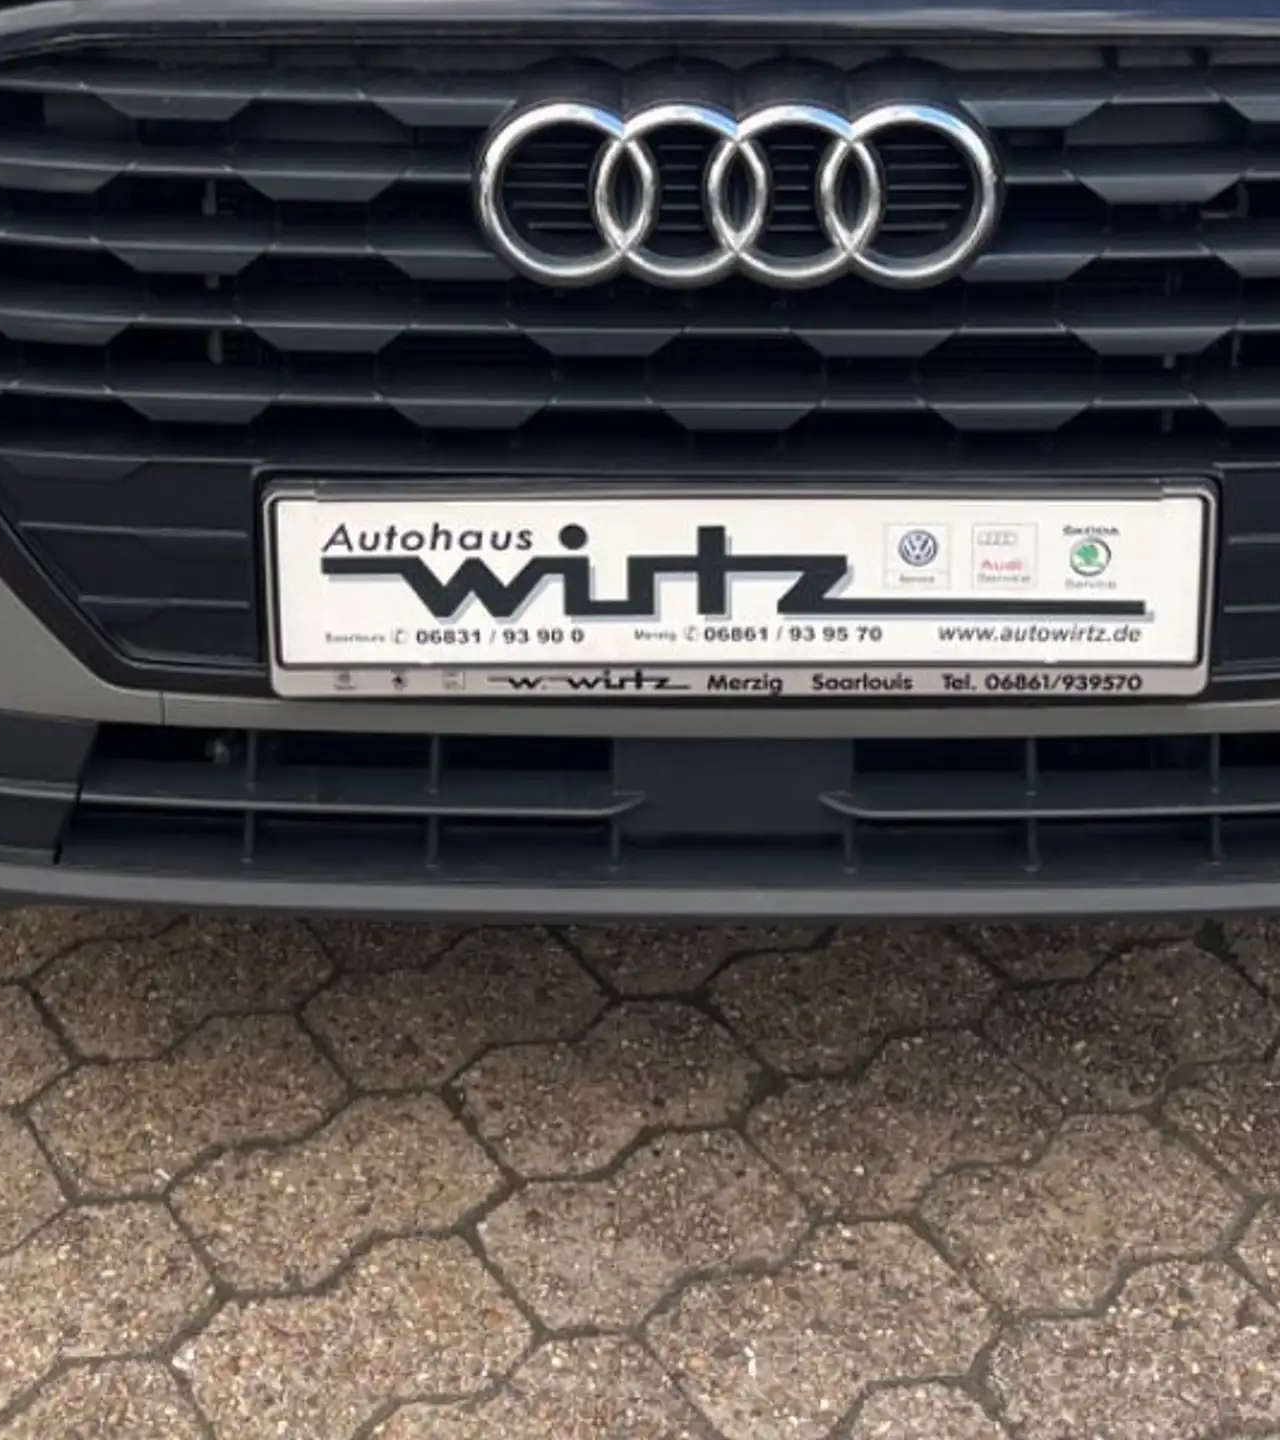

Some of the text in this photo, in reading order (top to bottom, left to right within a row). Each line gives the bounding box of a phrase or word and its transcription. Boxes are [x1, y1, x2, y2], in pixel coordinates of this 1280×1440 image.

[322, 523, 534, 551] Autohaus
[321, 523, 1146, 617] wirtz
[980, 560, 1024, 572] Audi
[416, 628, 482, 644] 06831
[503, 628, 530, 644] 93
[537, 628, 564, 644] 90
[571, 628, 585, 644] 0
[704, 626, 769, 643] 06861
[790, 626, 816, 643] 93
[822, 626, 848, 642] 95
[857, 626, 883, 642] 70
[938, 624, 1142, 643] www.autowirtz.de
[707, 673, 784, 694] Merzig
[812, 672, 914, 692] Saarlouis
[942, 672, 977, 692] Tel.
[984, 672, 1144, 692] 06861/939570
